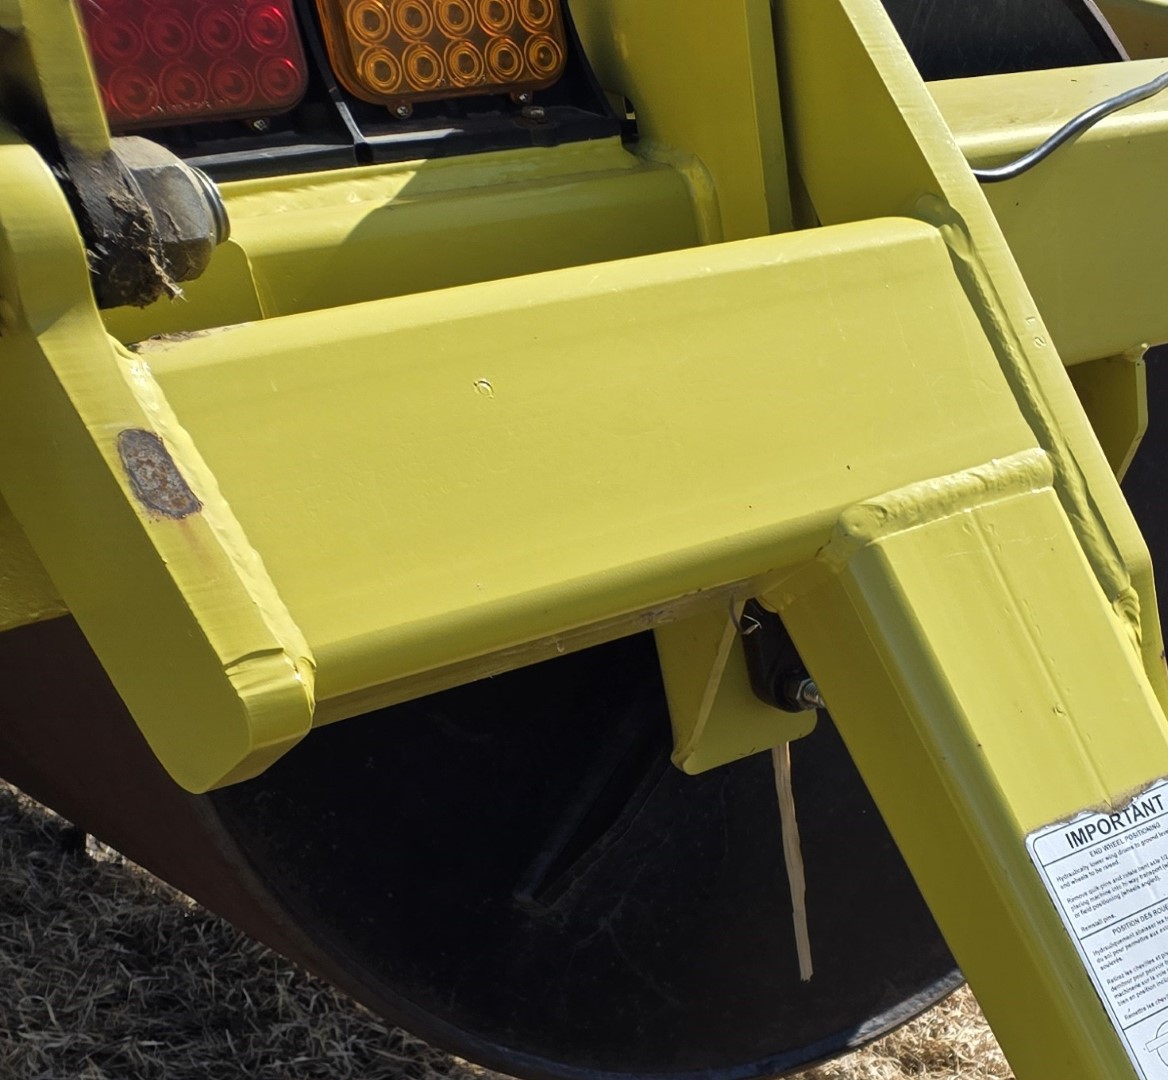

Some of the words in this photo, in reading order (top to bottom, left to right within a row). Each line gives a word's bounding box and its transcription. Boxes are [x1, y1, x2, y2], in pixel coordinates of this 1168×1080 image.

[1064, 794, 1167, 848] IMPORTANT
[1088, 846, 1103, 857] END
[1101, 837, 1124, 851] WHEEL
[1123, 821, 1161, 842] POSITIONING
[1111, 917, 1140, 935] POSITION
[1139, 911, 1152, 921] DES
